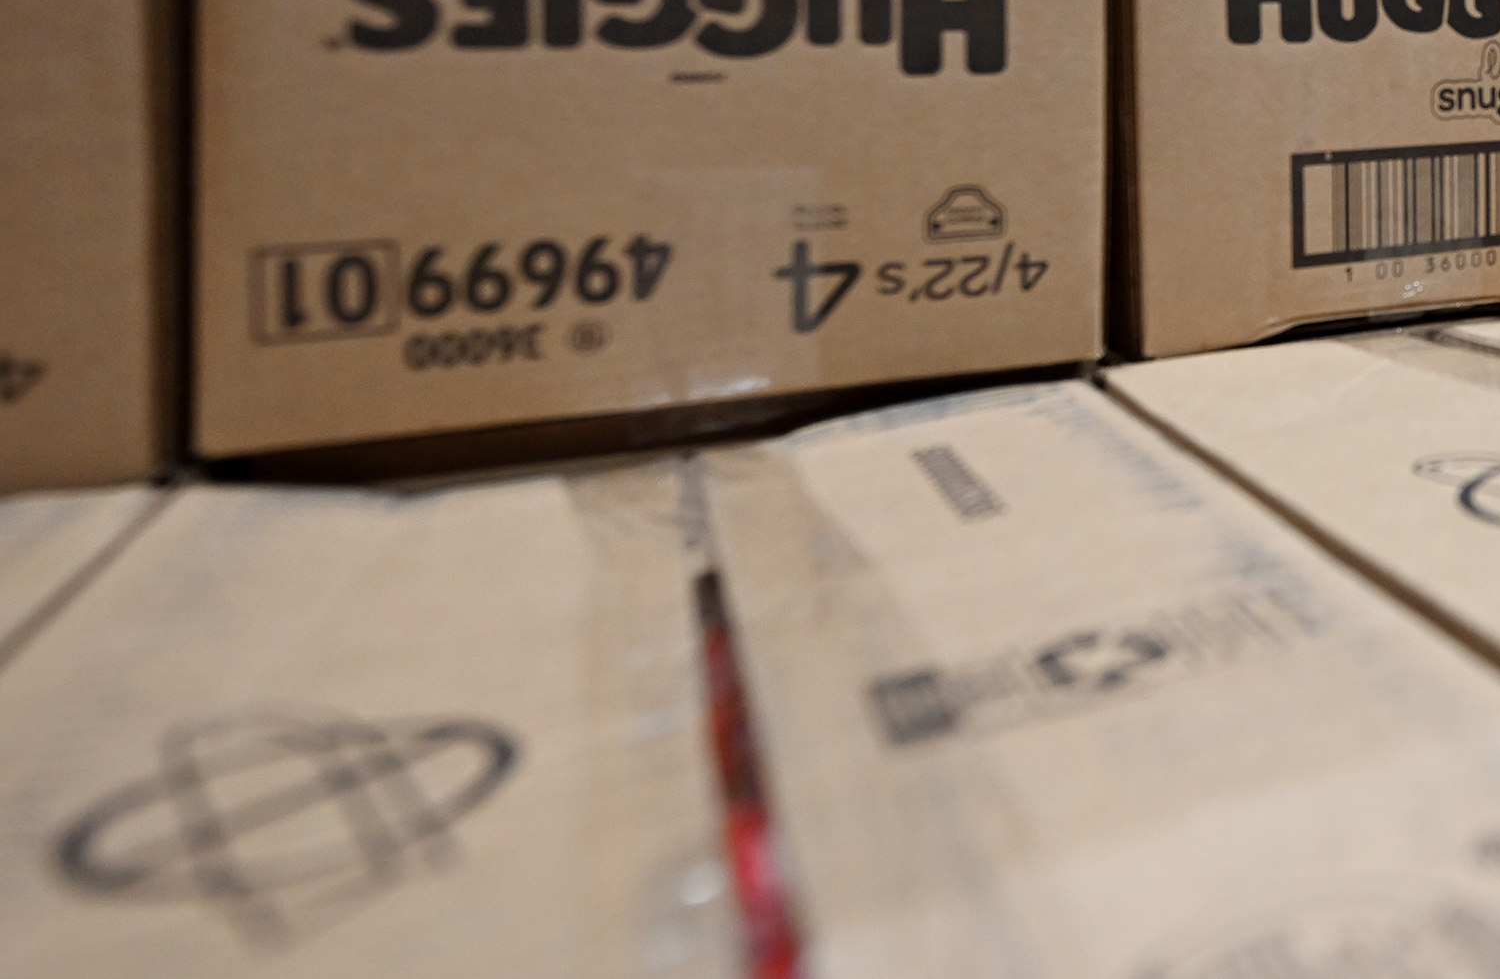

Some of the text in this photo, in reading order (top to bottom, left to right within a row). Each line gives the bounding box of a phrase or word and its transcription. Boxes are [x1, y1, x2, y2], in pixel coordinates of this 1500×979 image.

[280, 235, 672, 328] 49699 01
[773, 241, 1050, 335] 4/22's 4
[1346, 267, 1354, 282] 1
[1375, 261, 1404, 281] 00
[1426, 249, 1497, 274] 36000
[403, 323, 546, 370] 36000
